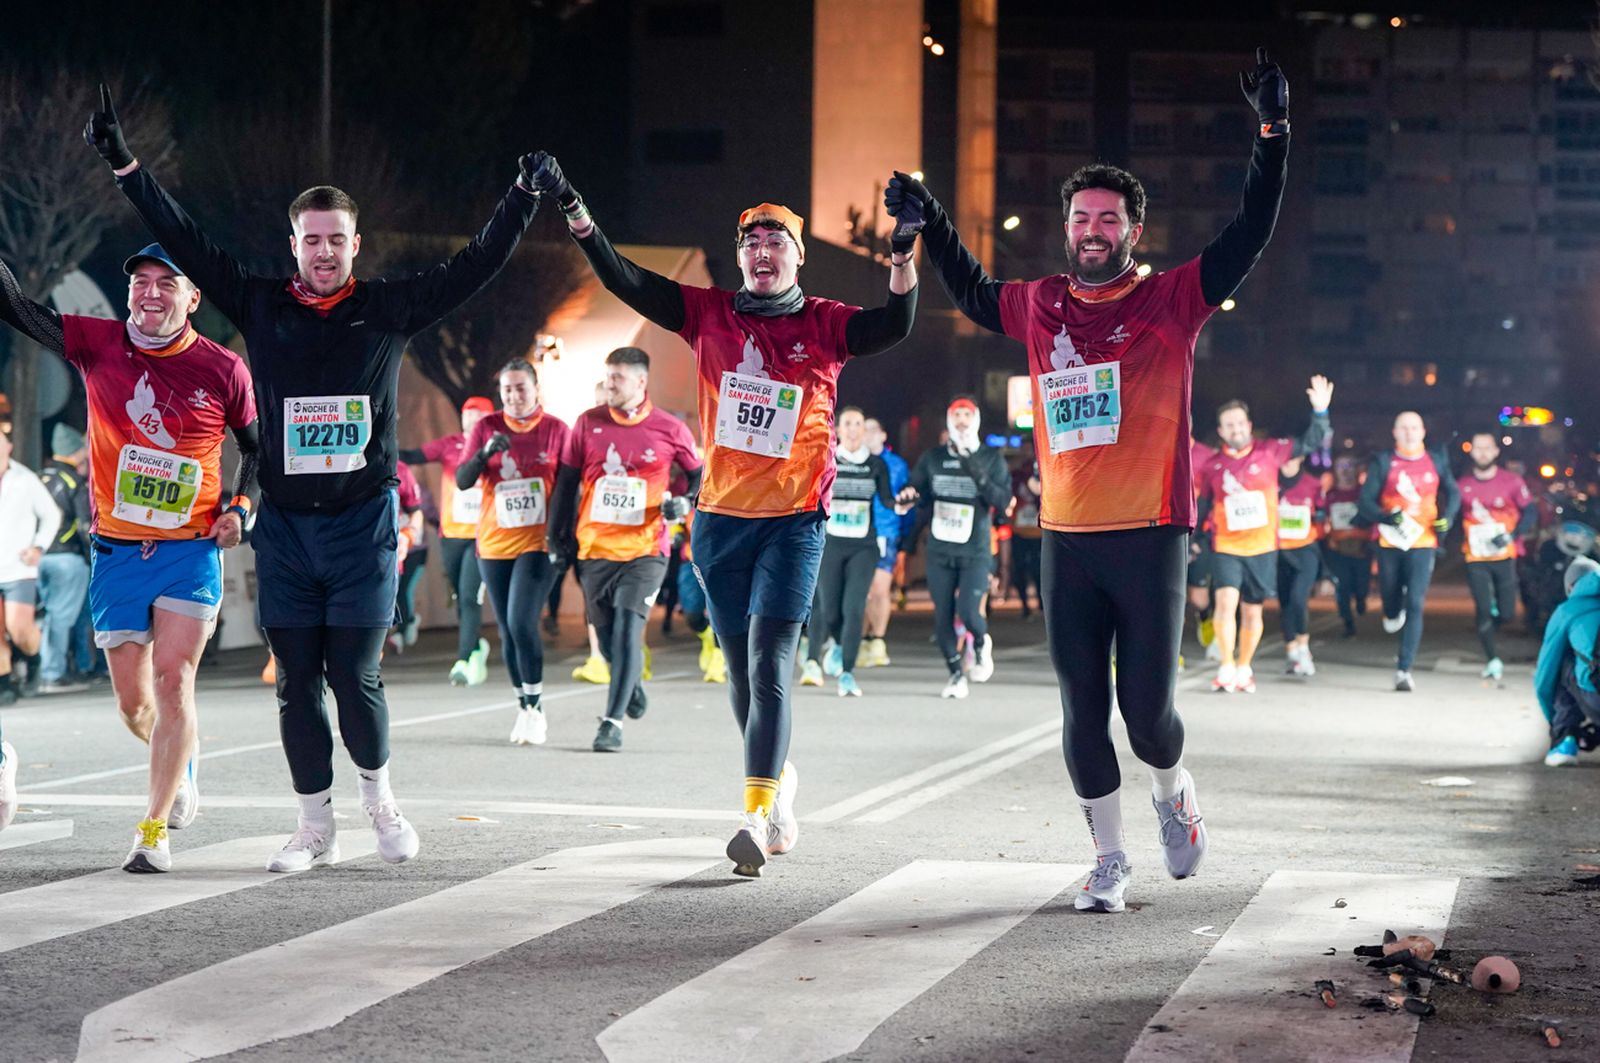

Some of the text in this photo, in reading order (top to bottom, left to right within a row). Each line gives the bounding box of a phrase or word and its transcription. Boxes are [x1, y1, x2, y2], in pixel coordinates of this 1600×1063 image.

[1054, 378, 1077, 388] NOCHE
[1078, 375, 1088, 385] DE
[728, 389, 743, 399] SAN
[737, 382, 761, 394] NOCHE
[761, 387, 772, 396] DE
[1049, 390, 1062, 400] SAN
[302, 405, 327, 413] NOCHE
[328, 404, 339, 412] DE
[737, 402, 776, 429] 597
[1052, 392, 1110, 425] 13752
[138, 413, 160, 435] 43
[293, 415, 309, 423] SAN
[296, 423, 359, 447] 12279
[748, 426, 769, 437] CARLOS
[127, 462, 144, 474] SAN
[137, 455, 161, 467] NOCHE
[162, 460, 174, 470] DE
[133, 474, 180, 504] 1510
[505, 495, 536, 511] 6521
[602, 492, 636, 508] 6524
